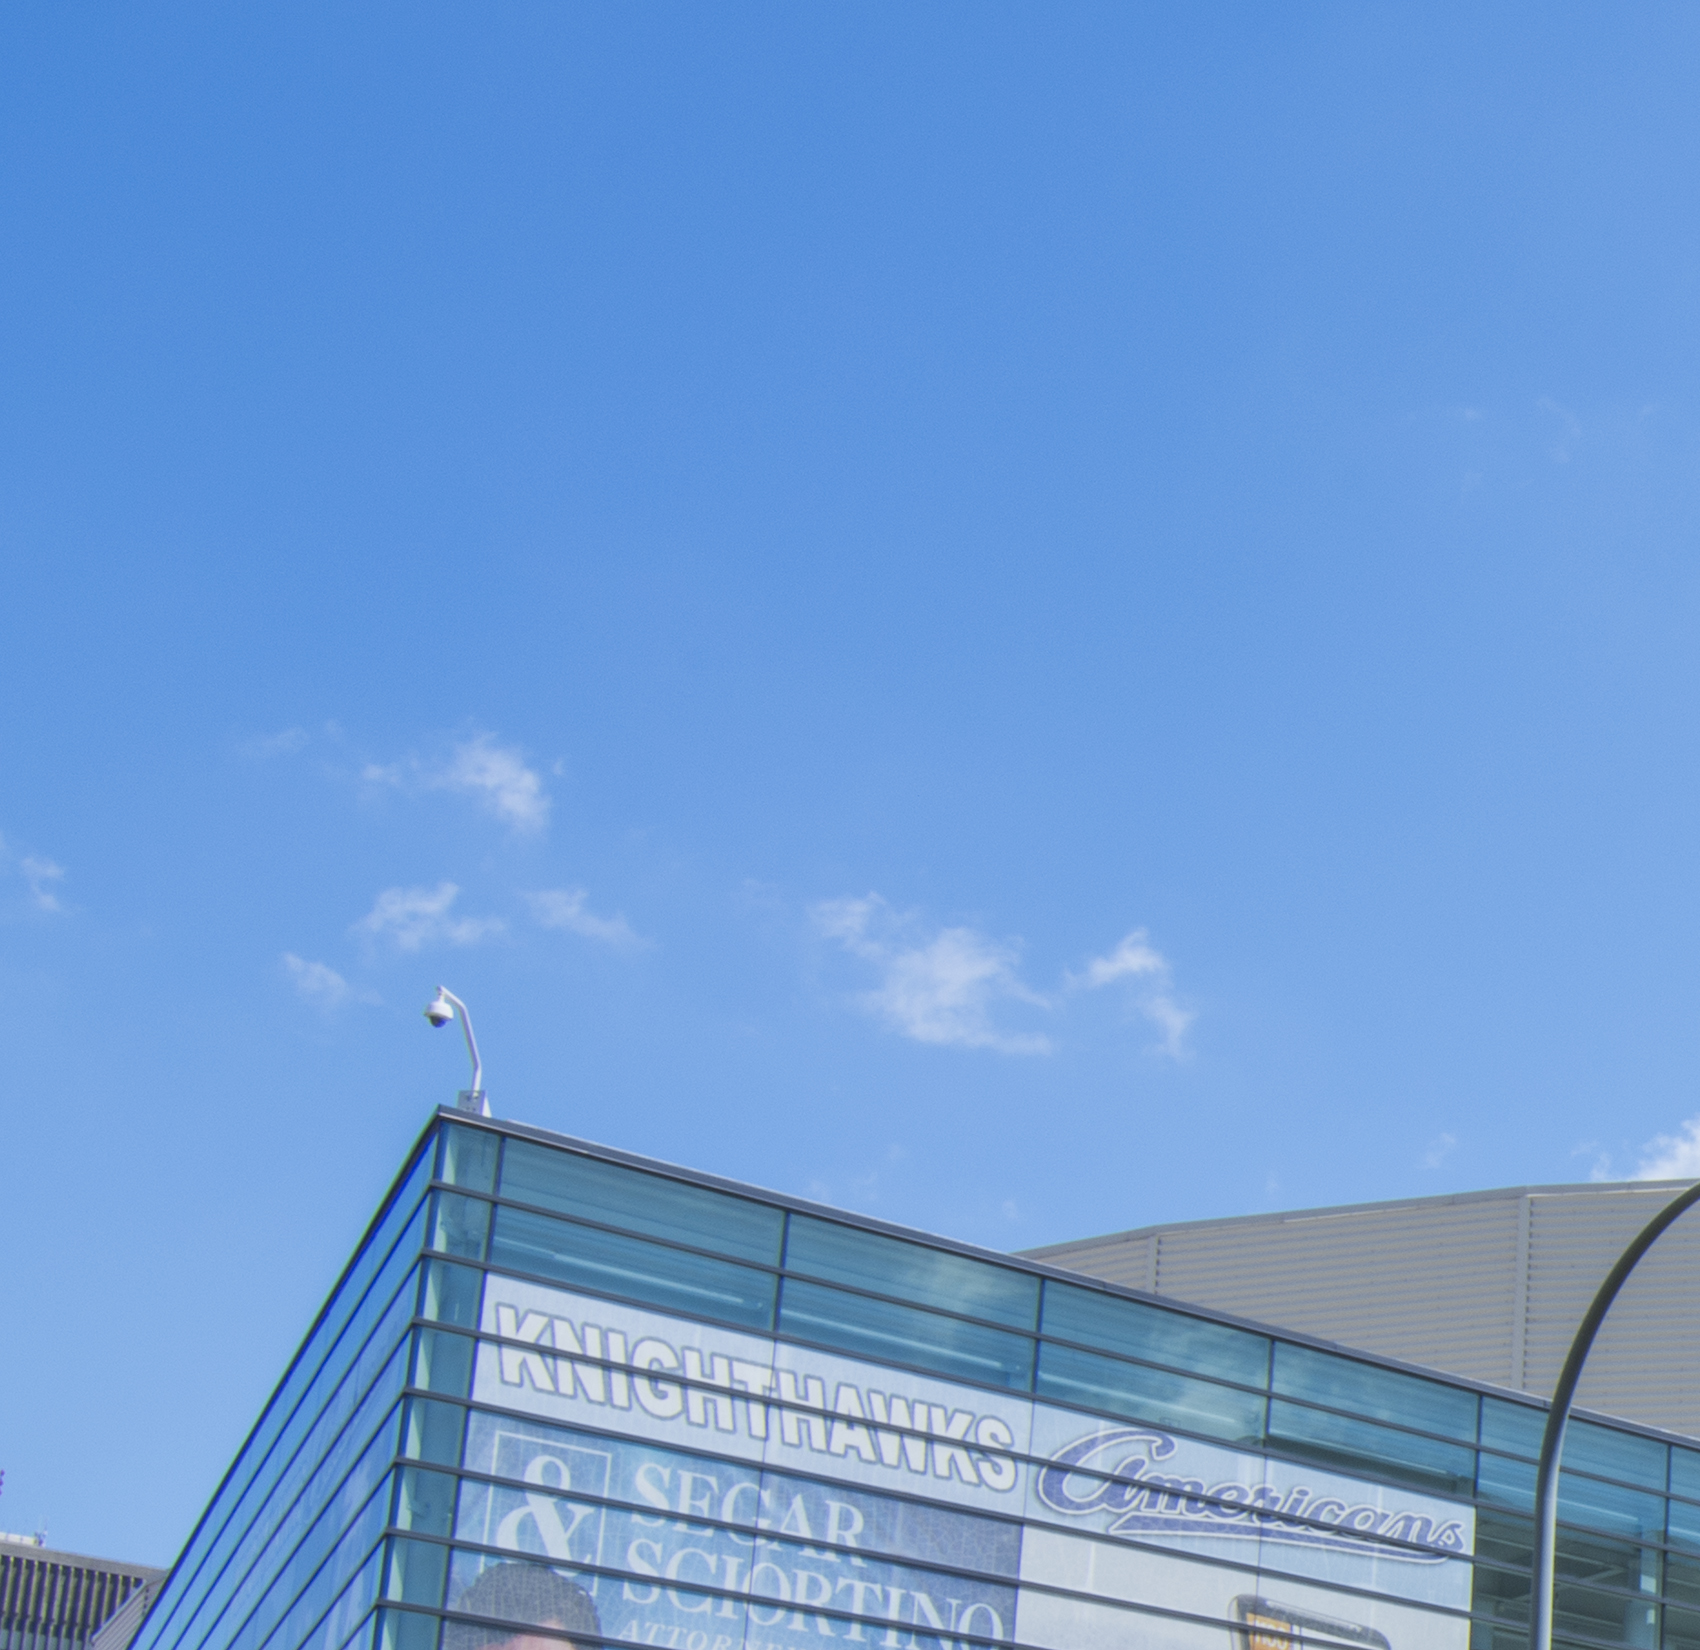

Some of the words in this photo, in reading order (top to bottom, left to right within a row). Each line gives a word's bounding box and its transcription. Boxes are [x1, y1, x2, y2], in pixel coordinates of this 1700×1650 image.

[496, 1303, 1019, 1492] KNIGHTHAWKS
[631, 1462, 868, 1567] SEGAR
[1037, 1427, 1466, 1560] Americans
